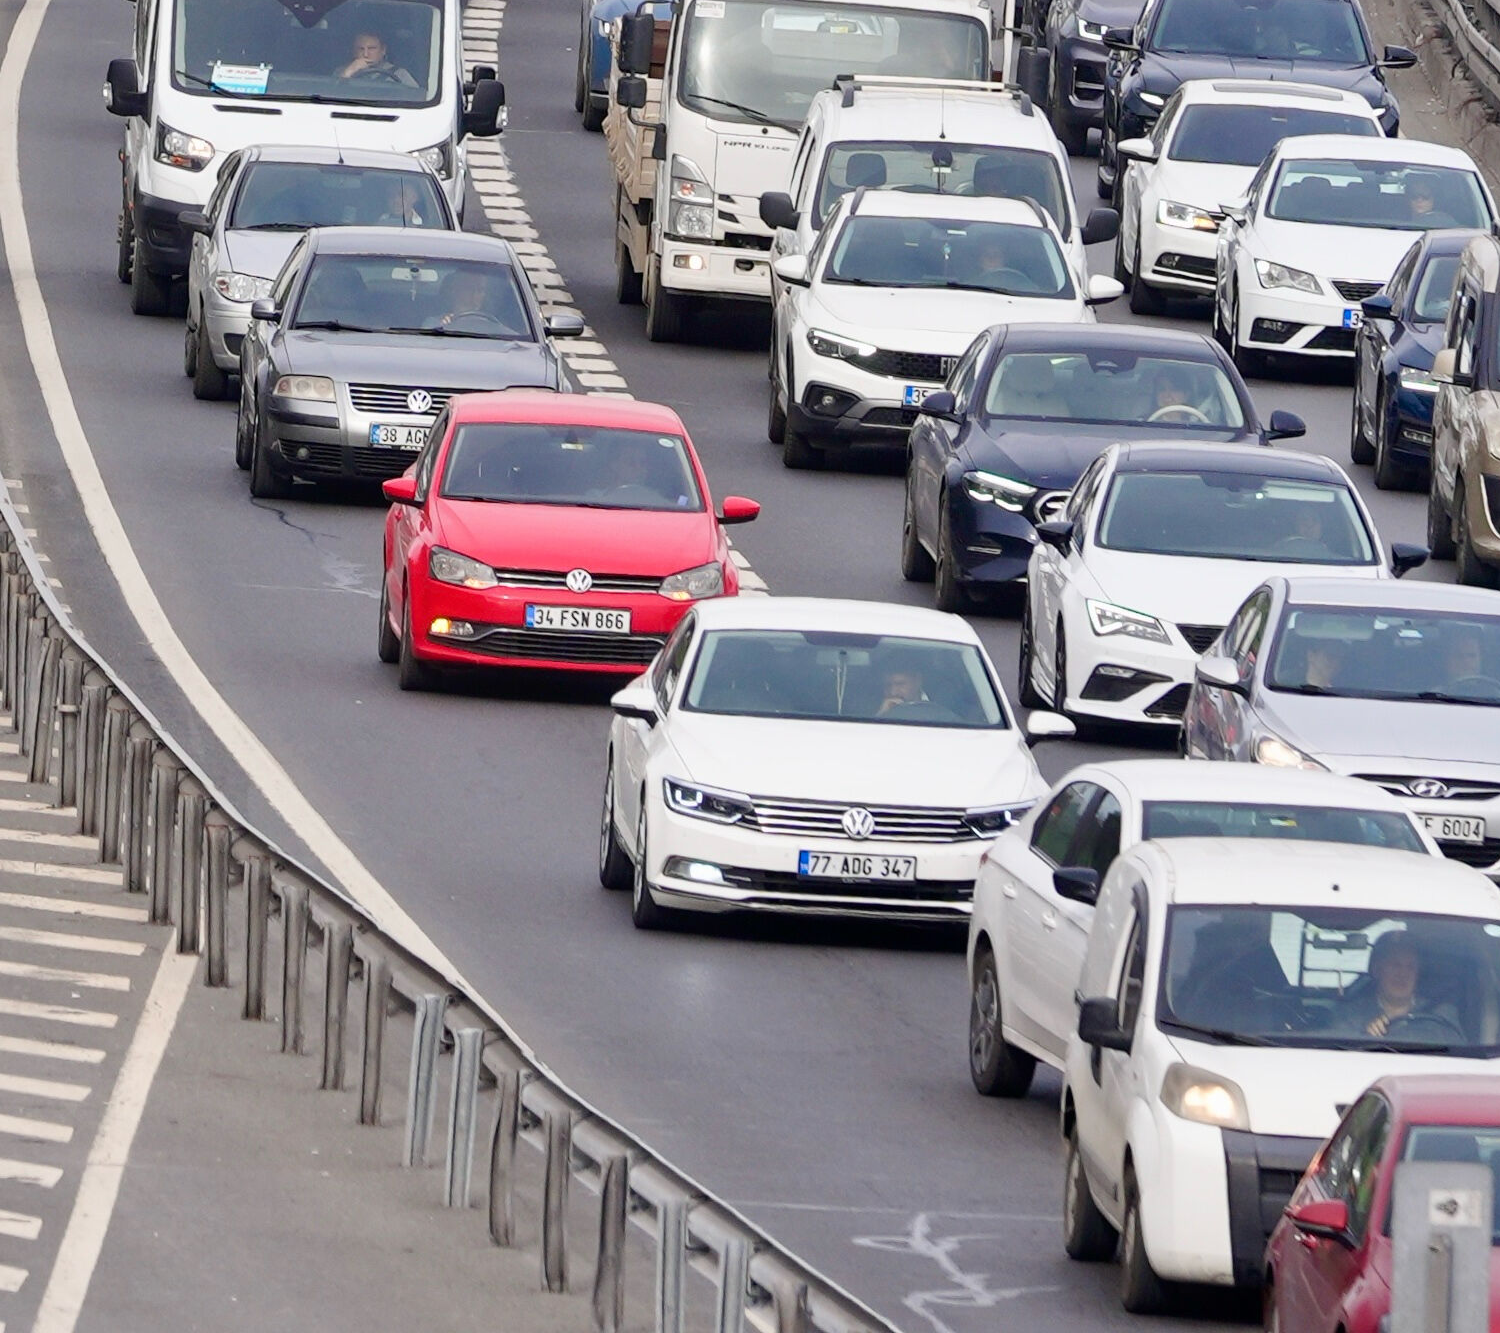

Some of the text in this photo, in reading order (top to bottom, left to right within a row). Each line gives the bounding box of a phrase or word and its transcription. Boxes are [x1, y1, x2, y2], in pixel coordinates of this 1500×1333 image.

[381, 428, 398, 443] 38
[534, 609, 625, 630] 34 FSN 866
[1442, 818, 1482, 839] 6004
[810, 854, 914, 878] 77 ADG 347
